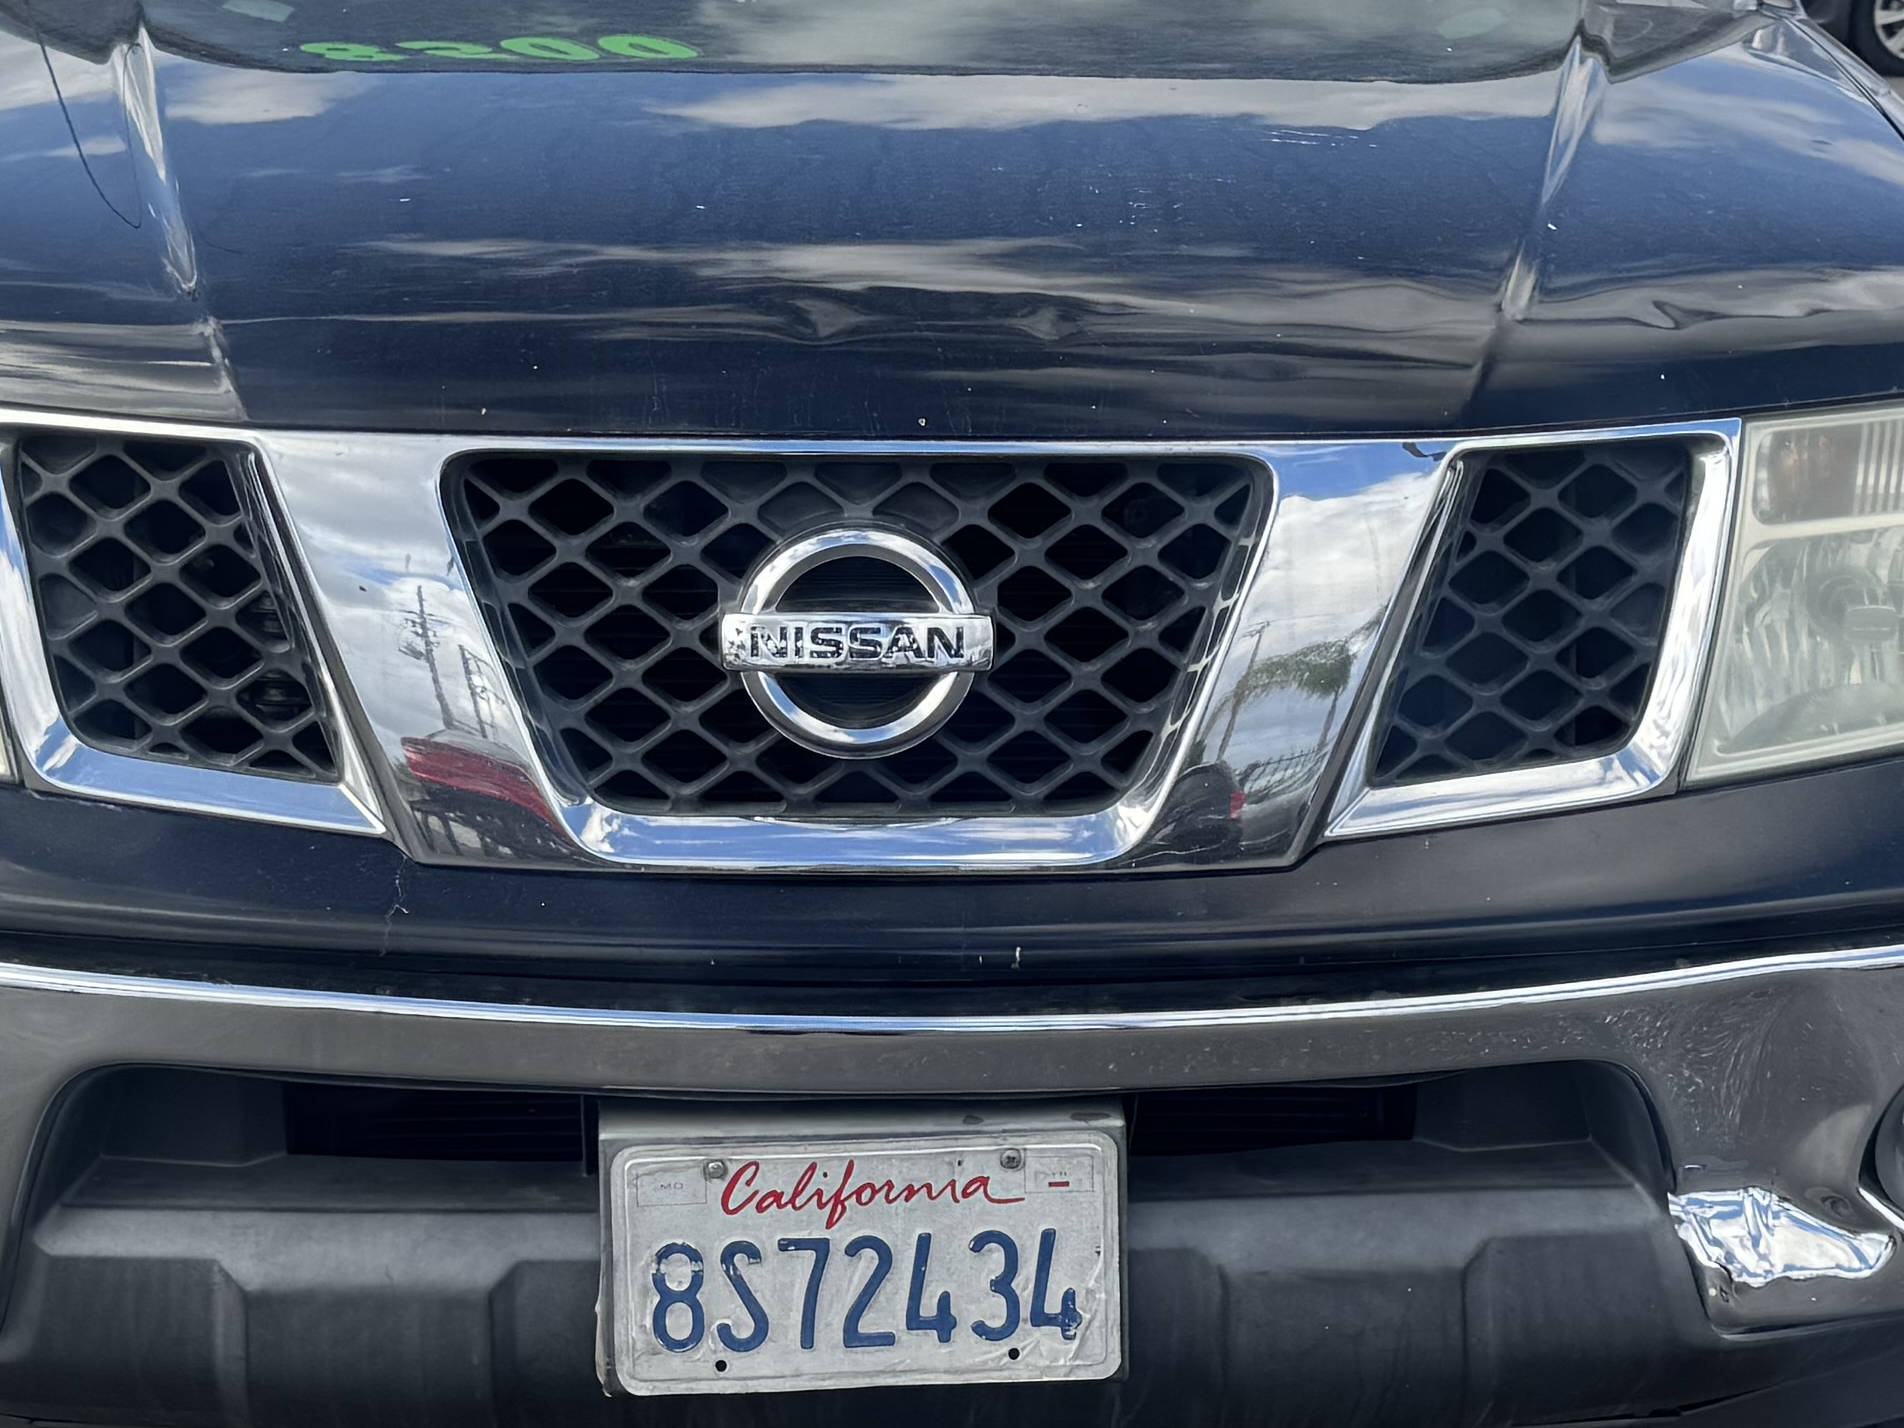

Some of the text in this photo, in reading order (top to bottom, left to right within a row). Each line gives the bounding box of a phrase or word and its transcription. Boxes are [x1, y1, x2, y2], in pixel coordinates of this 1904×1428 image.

[749, 625, 965, 660] NISSAN
[720, 1158, 1025, 1229] California
[651, 1228, 1083, 1353] 8S72434
